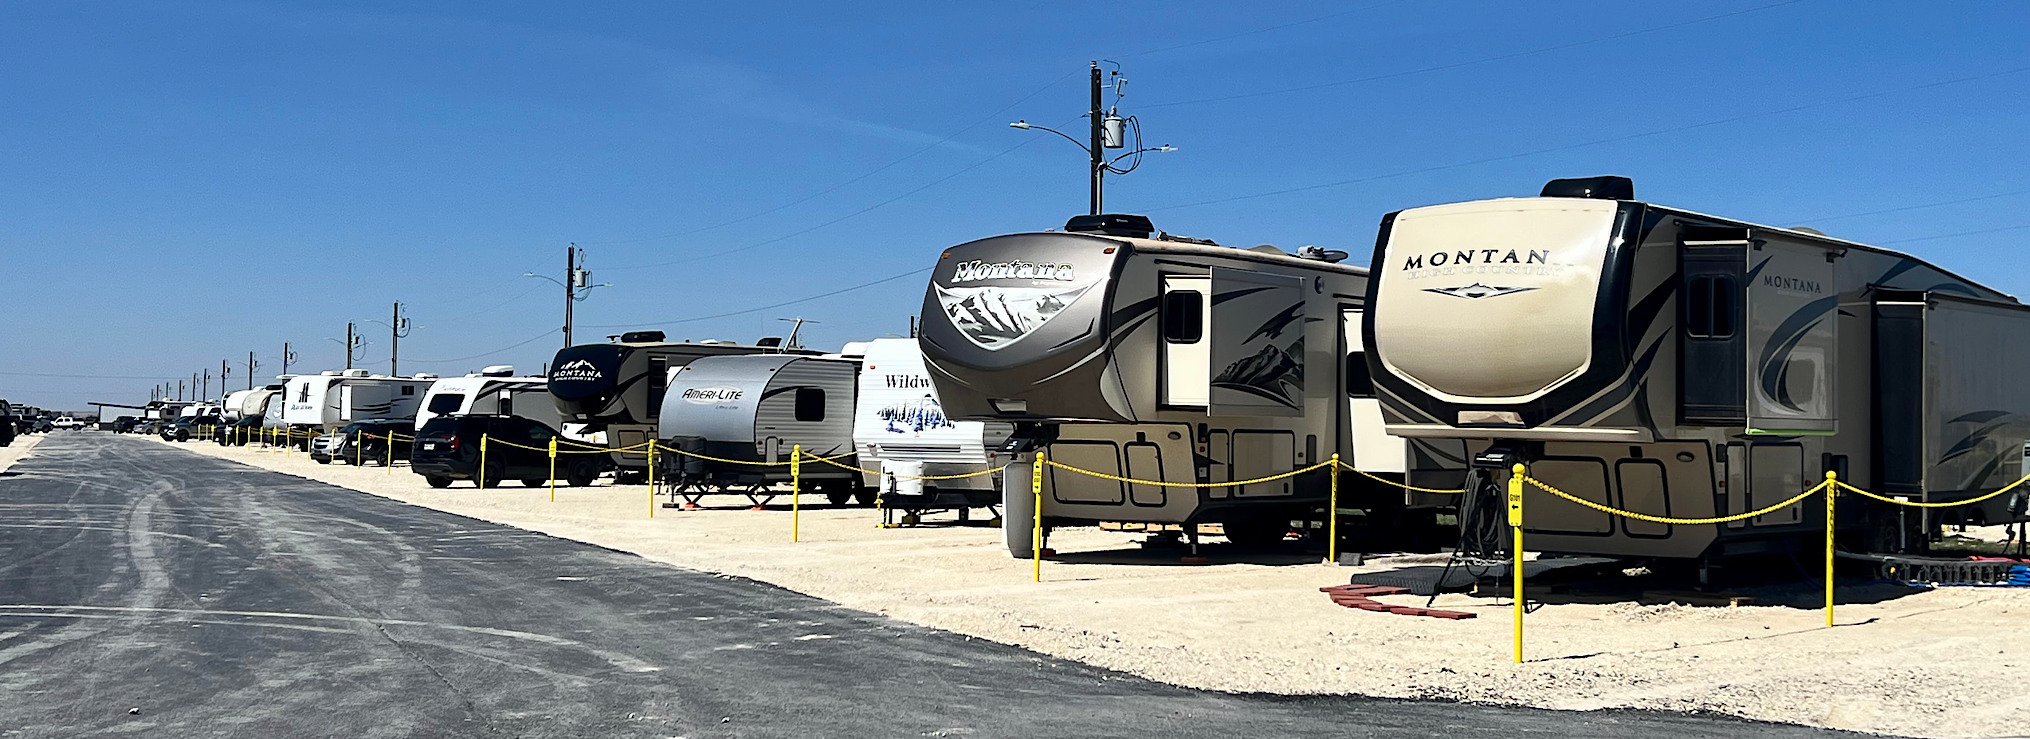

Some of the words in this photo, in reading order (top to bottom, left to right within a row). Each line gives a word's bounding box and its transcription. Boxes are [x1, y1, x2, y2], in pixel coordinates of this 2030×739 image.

[1402, 249, 1575, 271] MONTAN
[951, 259, 1076, 283] Montana
[1408, 266, 1456, 280] HIGH
[1763, 275, 1821, 294] MONTANA
[553, 370, 602, 378] MONTANA
